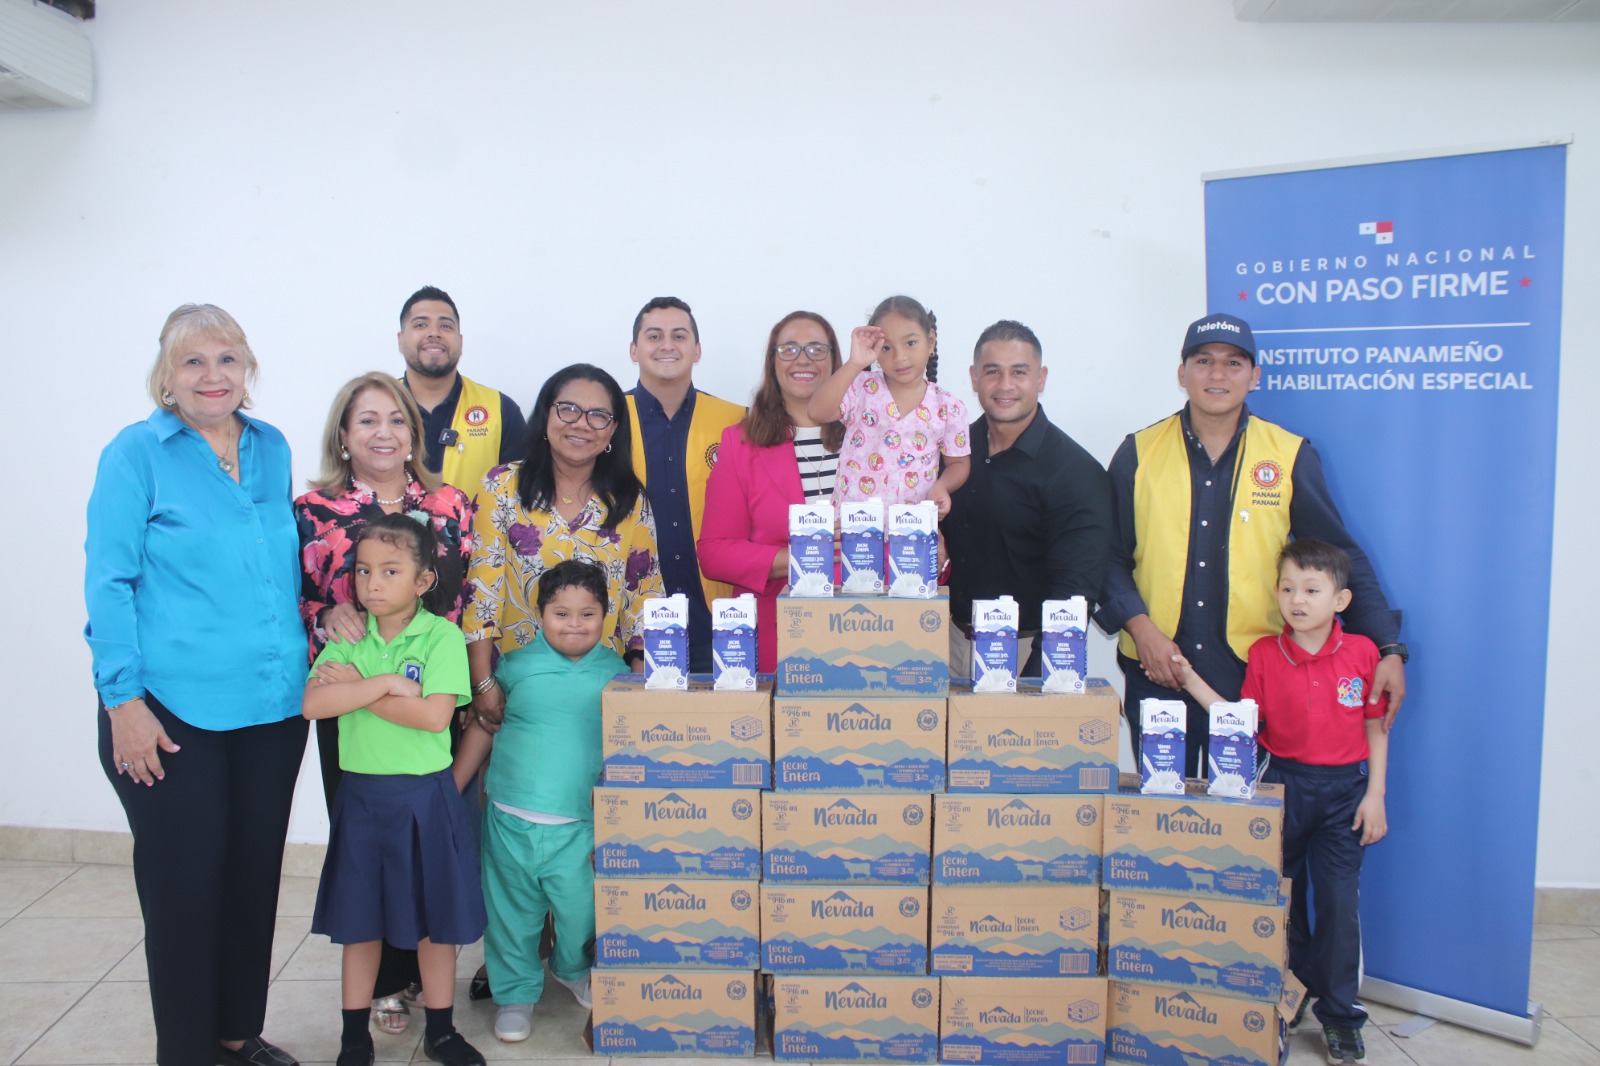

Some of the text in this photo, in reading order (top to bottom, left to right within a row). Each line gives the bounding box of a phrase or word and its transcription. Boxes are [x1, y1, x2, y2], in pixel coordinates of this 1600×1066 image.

[1236, 245, 1535, 275] GOBIERNO NACIONAL
[1256, 270, 1509, 306] CON PASO FIRME
[1255, 340, 1503, 366] NSTITUTO PANAMEÑO
[1268, 369, 1414, 391] HABILITACIÓN
[1423, 372, 1533, 390] ESPECIAL
[798, 515, 827, 524] Nevada
[848, 514, 877, 523] Nevada
[896, 515, 922, 525] Nevada
[651, 610, 679, 619] Nevada
[720, 610, 748, 619] Nevada
[984, 612, 1012, 621] Nevada
[1050, 612, 1078, 622] Nevada
[829, 613, 894, 634] Nevada
[827, 712, 892, 733] Nevada
[1150, 714, 1179, 724] Nevada
[1216, 716, 1245, 726] Nevada
[641, 730, 683, 742] Nevada
[988, 734, 1031, 748] Nevada
[644, 802, 707, 821] Nevada
[814, 807, 877, 828] Nevada
[987, 808, 1050, 828] Nevada
[1116, 807, 1130, 815] 946
[1156, 813, 1222, 836] Nevada
[644, 892, 706, 912] Nevada
[772, 896, 786, 904] 946
[1122, 900, 1136, 910] 946
[811, 899, 874, 919] Nevada
[969, 919, 1012, 933] Nevada
[1161, 908, 1227, 933] Nevada
[641, 983, 702, 1001] Nevada
[785, 987, 800, 995] 946
[825, 991, 887, 1011] Nevada
[1155, 995, 1218, 1025] Nevada
[979, 1011, 1021, 1024] Nevada
